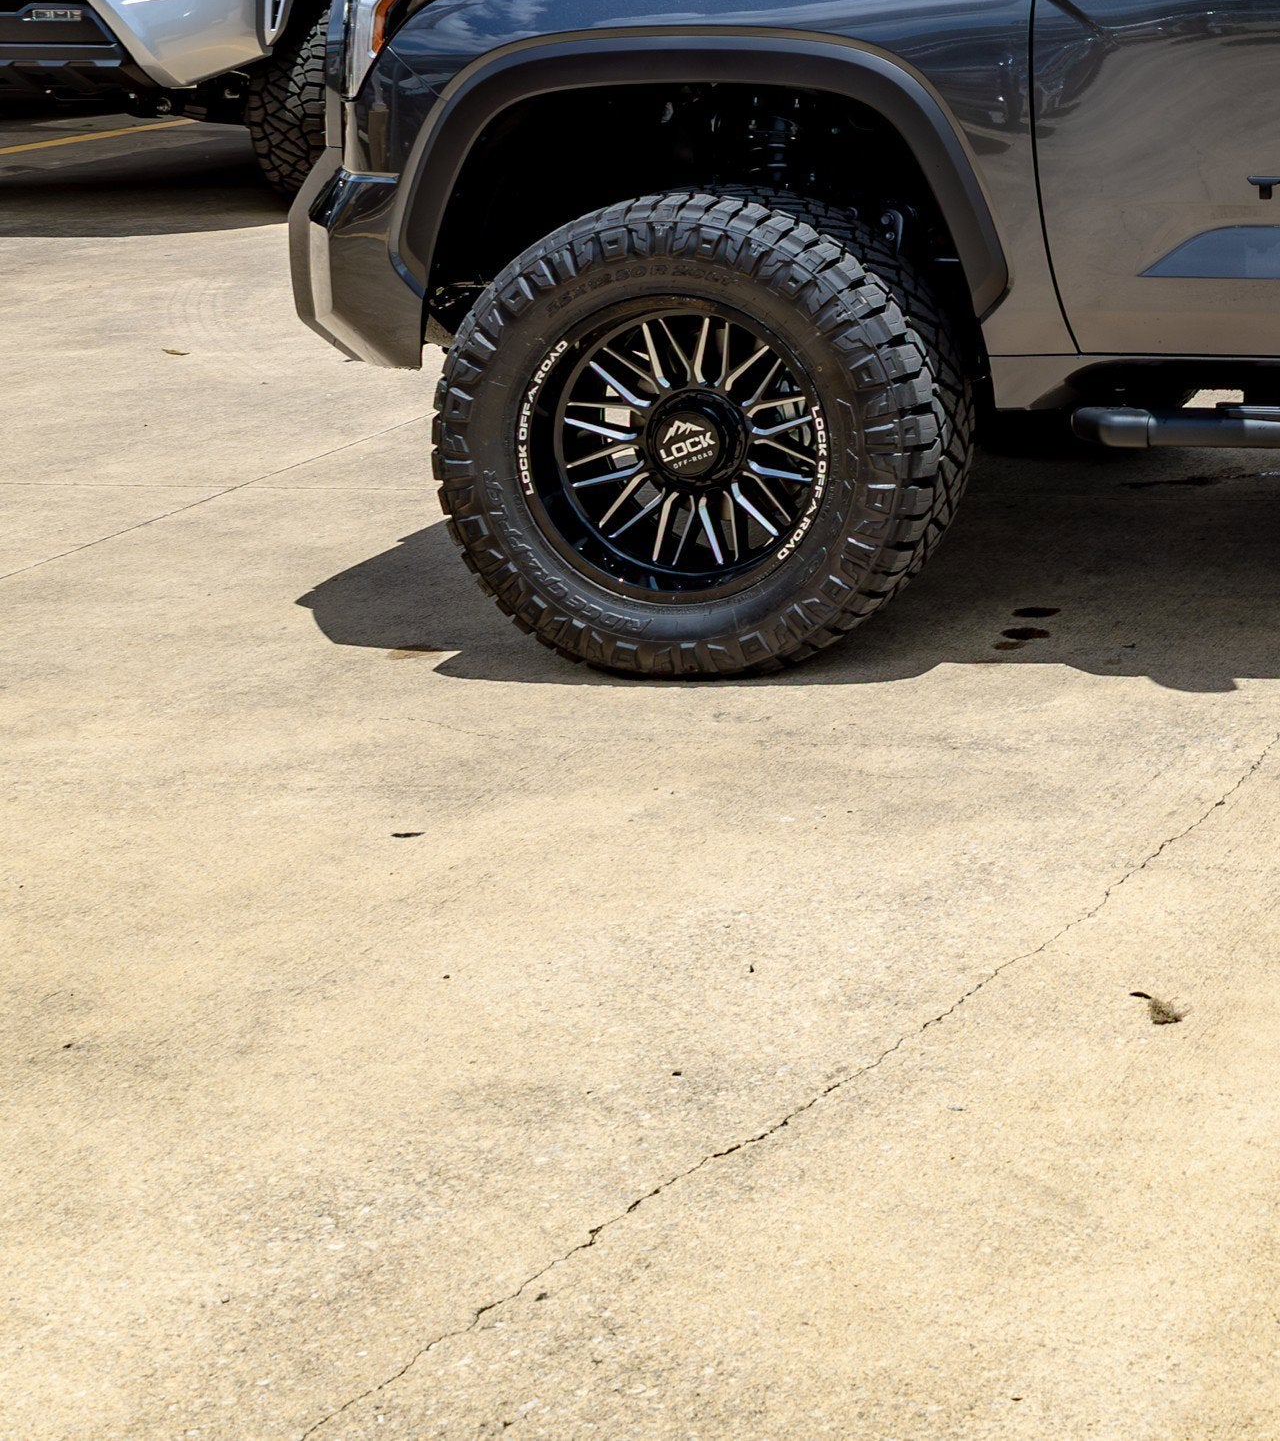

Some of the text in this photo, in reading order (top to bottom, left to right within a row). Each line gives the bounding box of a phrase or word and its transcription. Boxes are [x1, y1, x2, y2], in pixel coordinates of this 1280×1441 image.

[518, 340, 568, 496] LOCK OFF ROAD
[660, 431, 716, 463] LOCK
[672, 450, 713, 469] OFF-ROAD
[777, 405, 827, 560] LOCK OFF ROAD
